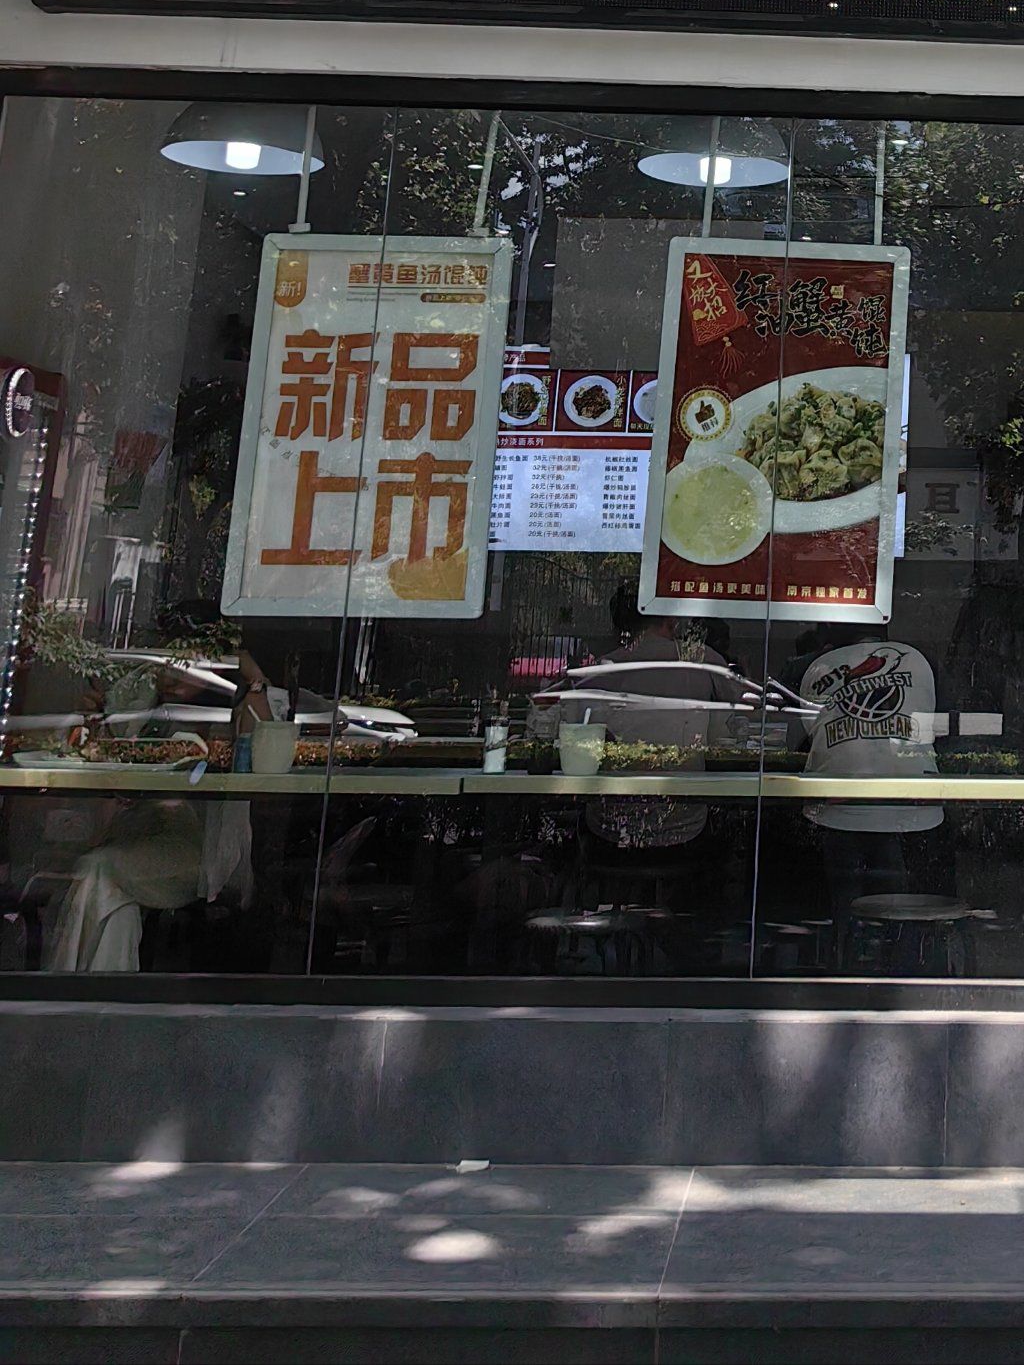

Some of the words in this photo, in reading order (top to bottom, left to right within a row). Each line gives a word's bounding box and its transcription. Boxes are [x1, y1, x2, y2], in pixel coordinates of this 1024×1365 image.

[274, 328, 480, 442] 新品
[260, 449, 473, 566] 上市
[786, 584, 869, 600] 南京独家首发
[825, 671, 913, 712] SOUTHWEST
